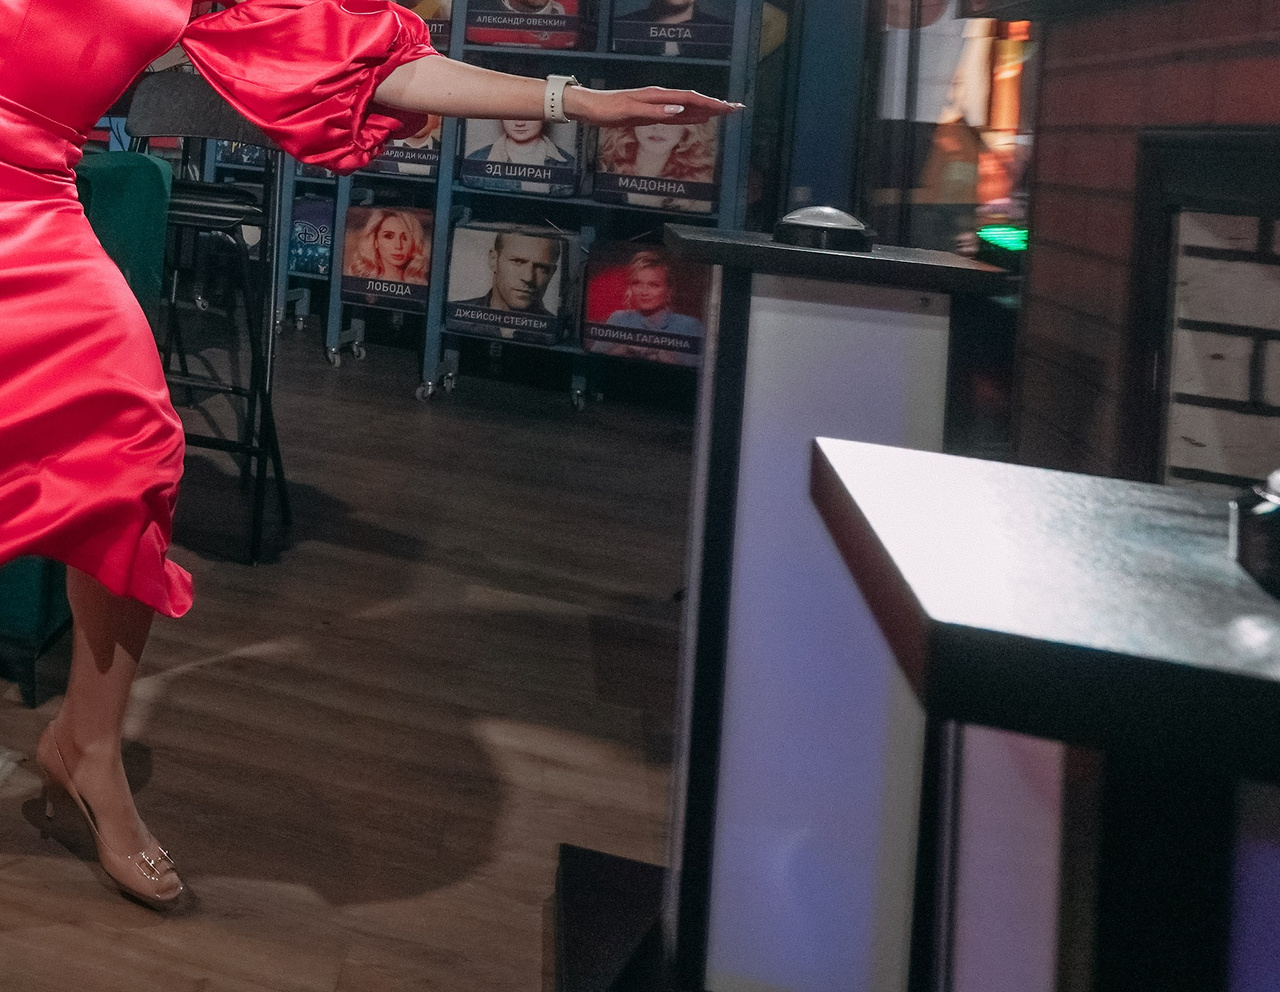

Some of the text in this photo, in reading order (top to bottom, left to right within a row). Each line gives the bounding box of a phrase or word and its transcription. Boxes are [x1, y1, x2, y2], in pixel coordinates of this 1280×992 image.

[429, 23, 445, 33] ЛТ
[476, 15, 566, 27] АЛЕКСАНДР ОВЕЧКИН
[649, 26, 692, 39] БАСТА
[485, 163, 552, 179] ЭД ШИРАН
[618, 177, 686, 194] МАДОННА
[366, 280, 412, 295] ЛОБОДА
[454, 308, 548, 330] ДЖЕЙСОН СТЕЙТЕМ
[590, 326, 691, 350] ПОЛИНА ГАГАРИНА
